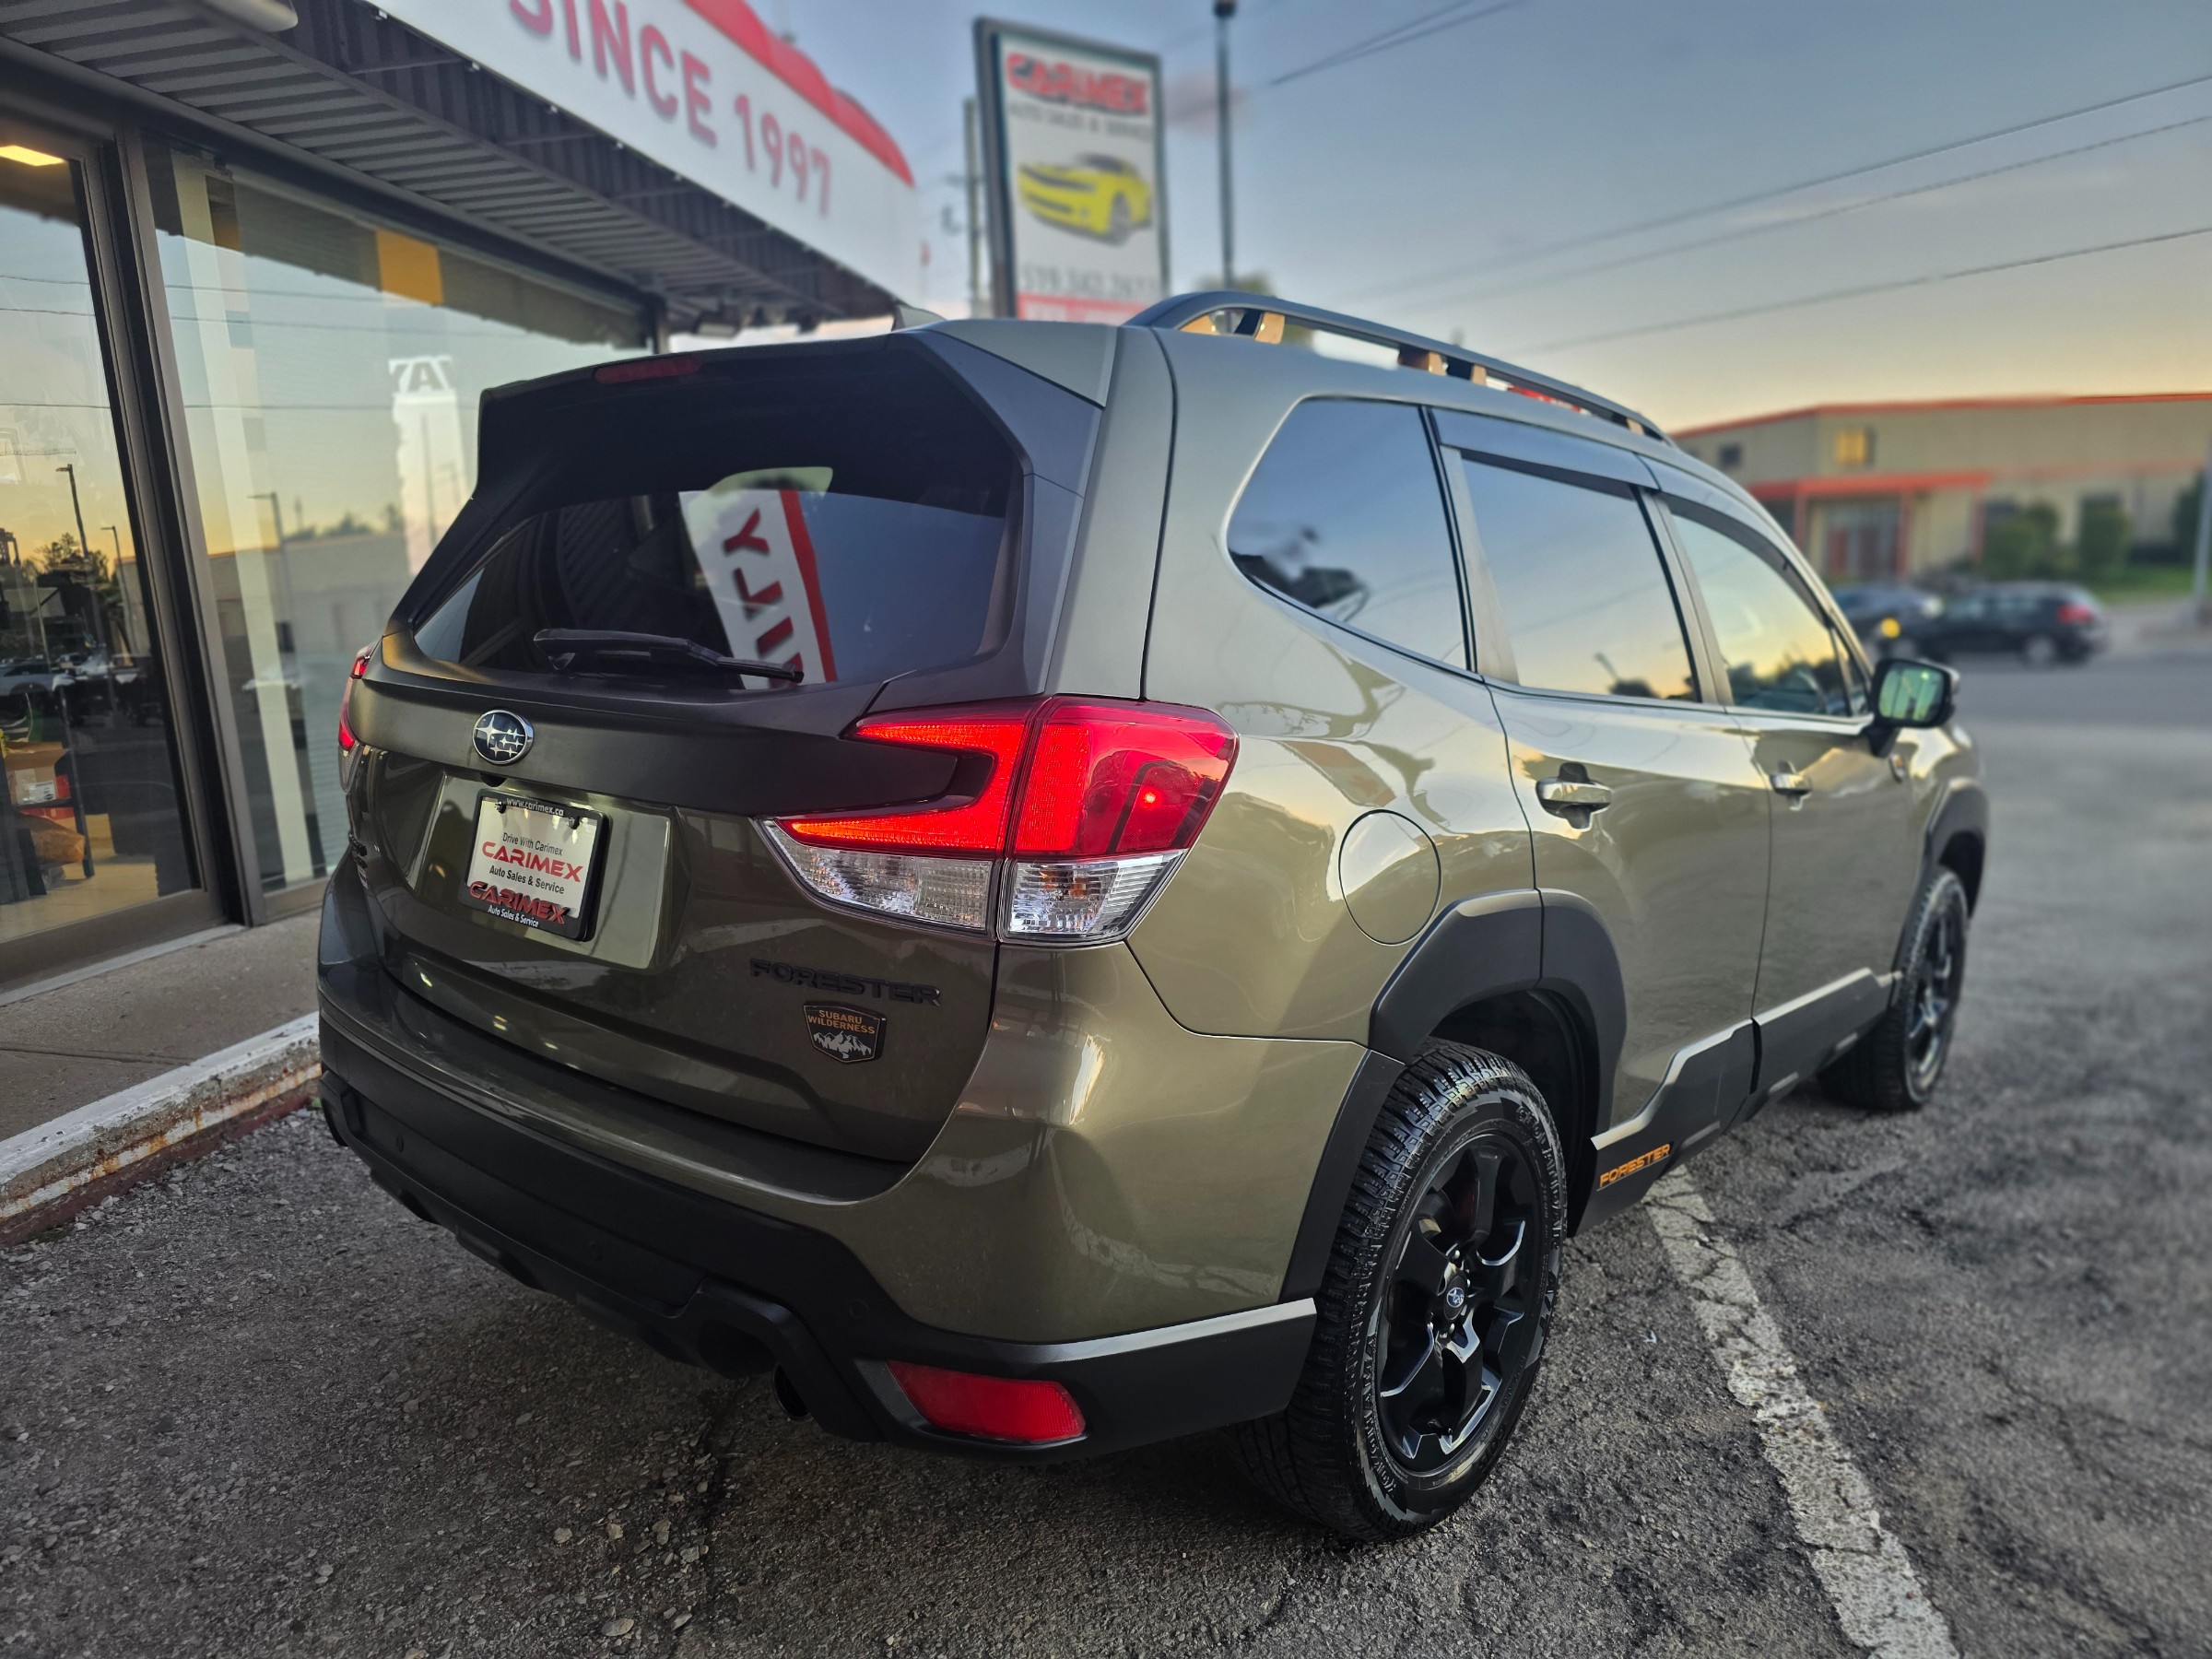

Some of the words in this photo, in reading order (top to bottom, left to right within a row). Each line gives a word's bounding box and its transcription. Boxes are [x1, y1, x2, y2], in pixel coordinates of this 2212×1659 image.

[735, 94, 830, 216] 1997
[506, 797, 564, 817] www.carimex.ca
[502, 832, 518, 844] Drive
[520, 837, 534, 849] With
[535, 840, 563, 856] Carimex
[482, 841, 583, 883] CARIMEX
[489, 865, 505, 877] Auto
[506, 869, 526, 884] Sales
[527, 876, 534, 886] &
[535, 877, 565, 895] Service
[468, 880, 571, 925] CARIMEX
[488, 904, 500, 916] Auto
[500, 908, 515, 921] Sales
[515, 912, 521, 922] &
[520, 915, 539, 928] Service
[750, 959, 942, 1006] FORESTER
[807, 1015, 876, 1035] WILDERNESS
[818, 1009, 863, 1025] SUBARU
[1598, 1143, 1670, 1188] FORESTER
